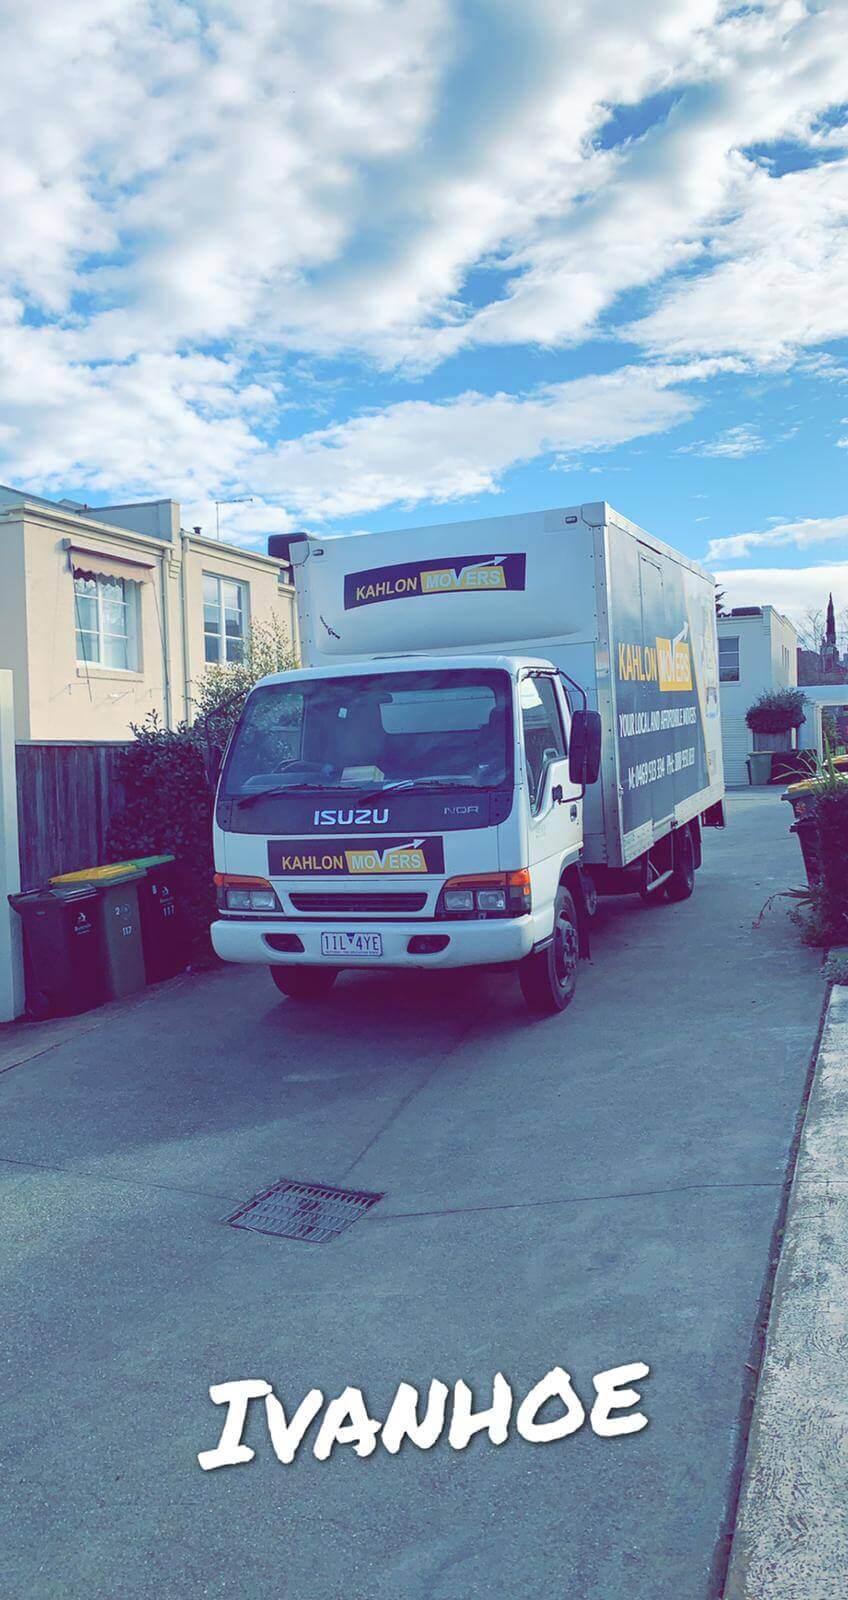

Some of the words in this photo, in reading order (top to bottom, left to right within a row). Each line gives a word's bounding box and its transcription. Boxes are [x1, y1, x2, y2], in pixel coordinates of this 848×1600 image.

[356, 577, 417, 601] KAHLON
[426, 567, 501, 590] MOVERS
[618, 642, 657, 682] KAHLON
[659, 639, 690, 683] MOVERS
[619, 712, 635, 738] YOUR
[635, 711, 651, 735] LOCAL
[651, 710, 660, 732] AND
[313, 808, 389, 826] ISUZU
[281, 854, 344, 871] KAHLON
[351, 850, 422, 870] MOVERS
